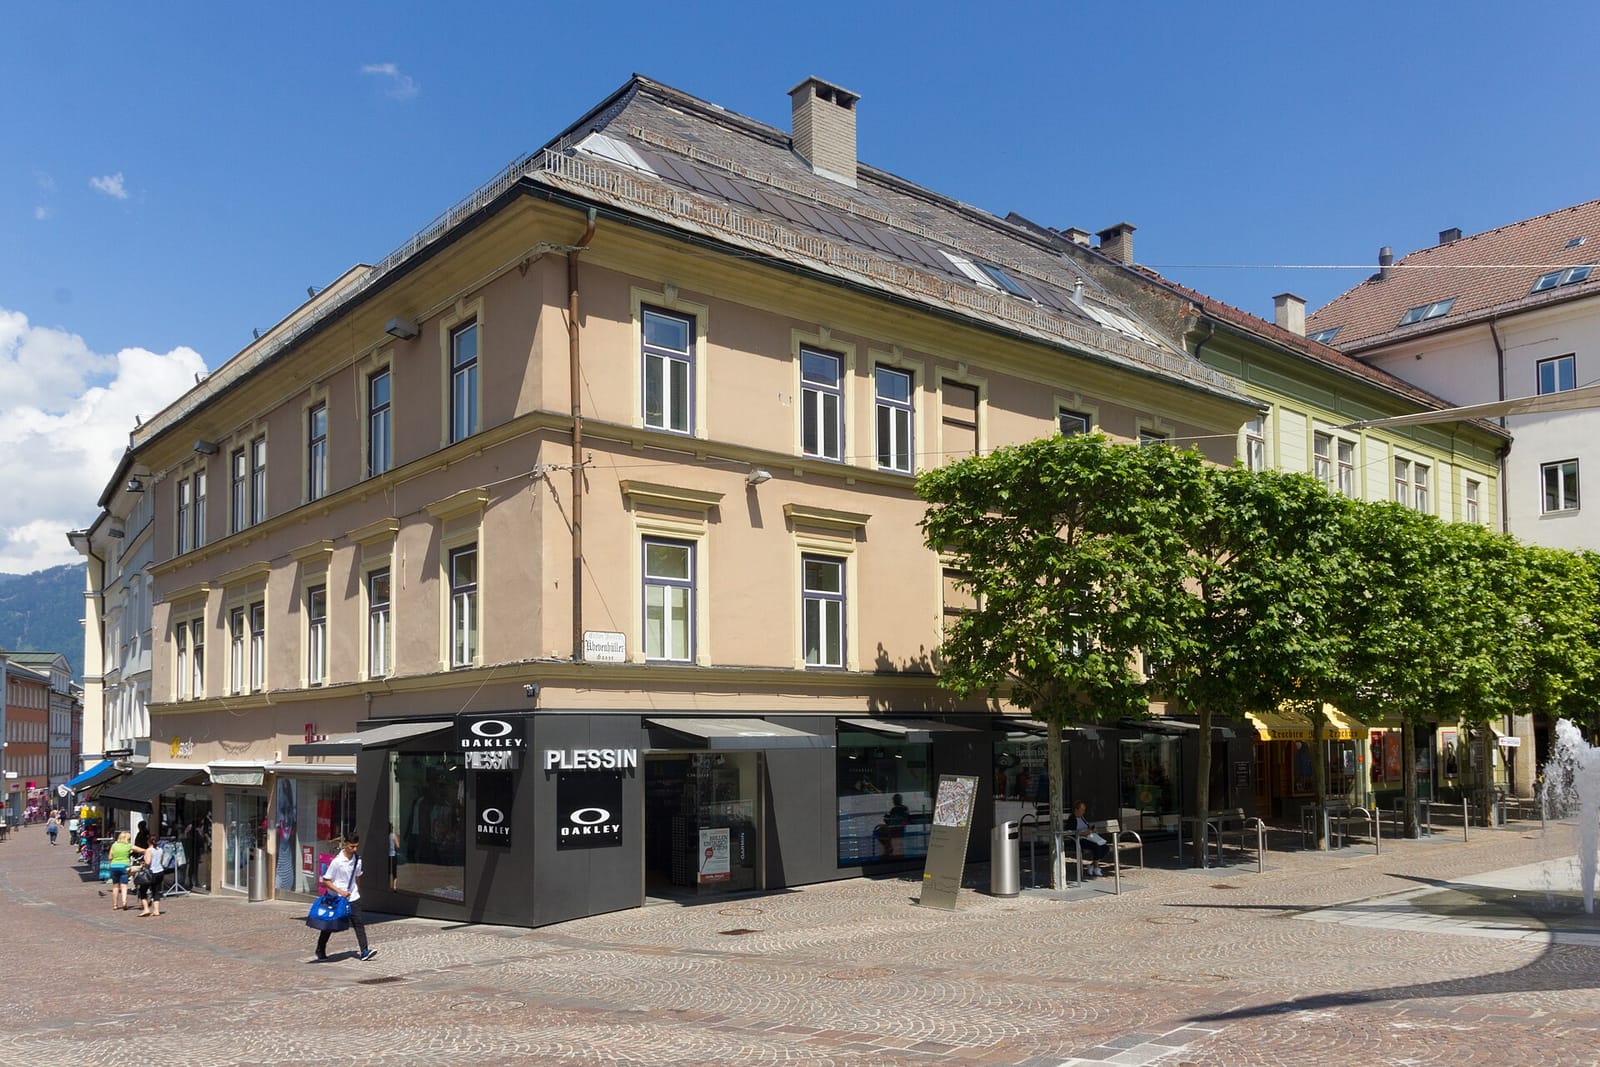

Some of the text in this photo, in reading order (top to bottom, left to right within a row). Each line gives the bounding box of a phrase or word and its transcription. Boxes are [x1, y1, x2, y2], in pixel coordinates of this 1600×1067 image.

[461, 738, 522, 747] OAKLEY
[464, 750, 514, 770] PLESSIN
[544, 748, 638, 770] PLESSIN
[477, 824, 510, 836] OAKLEY
[560, 824, 620, 836] OAKLEY
